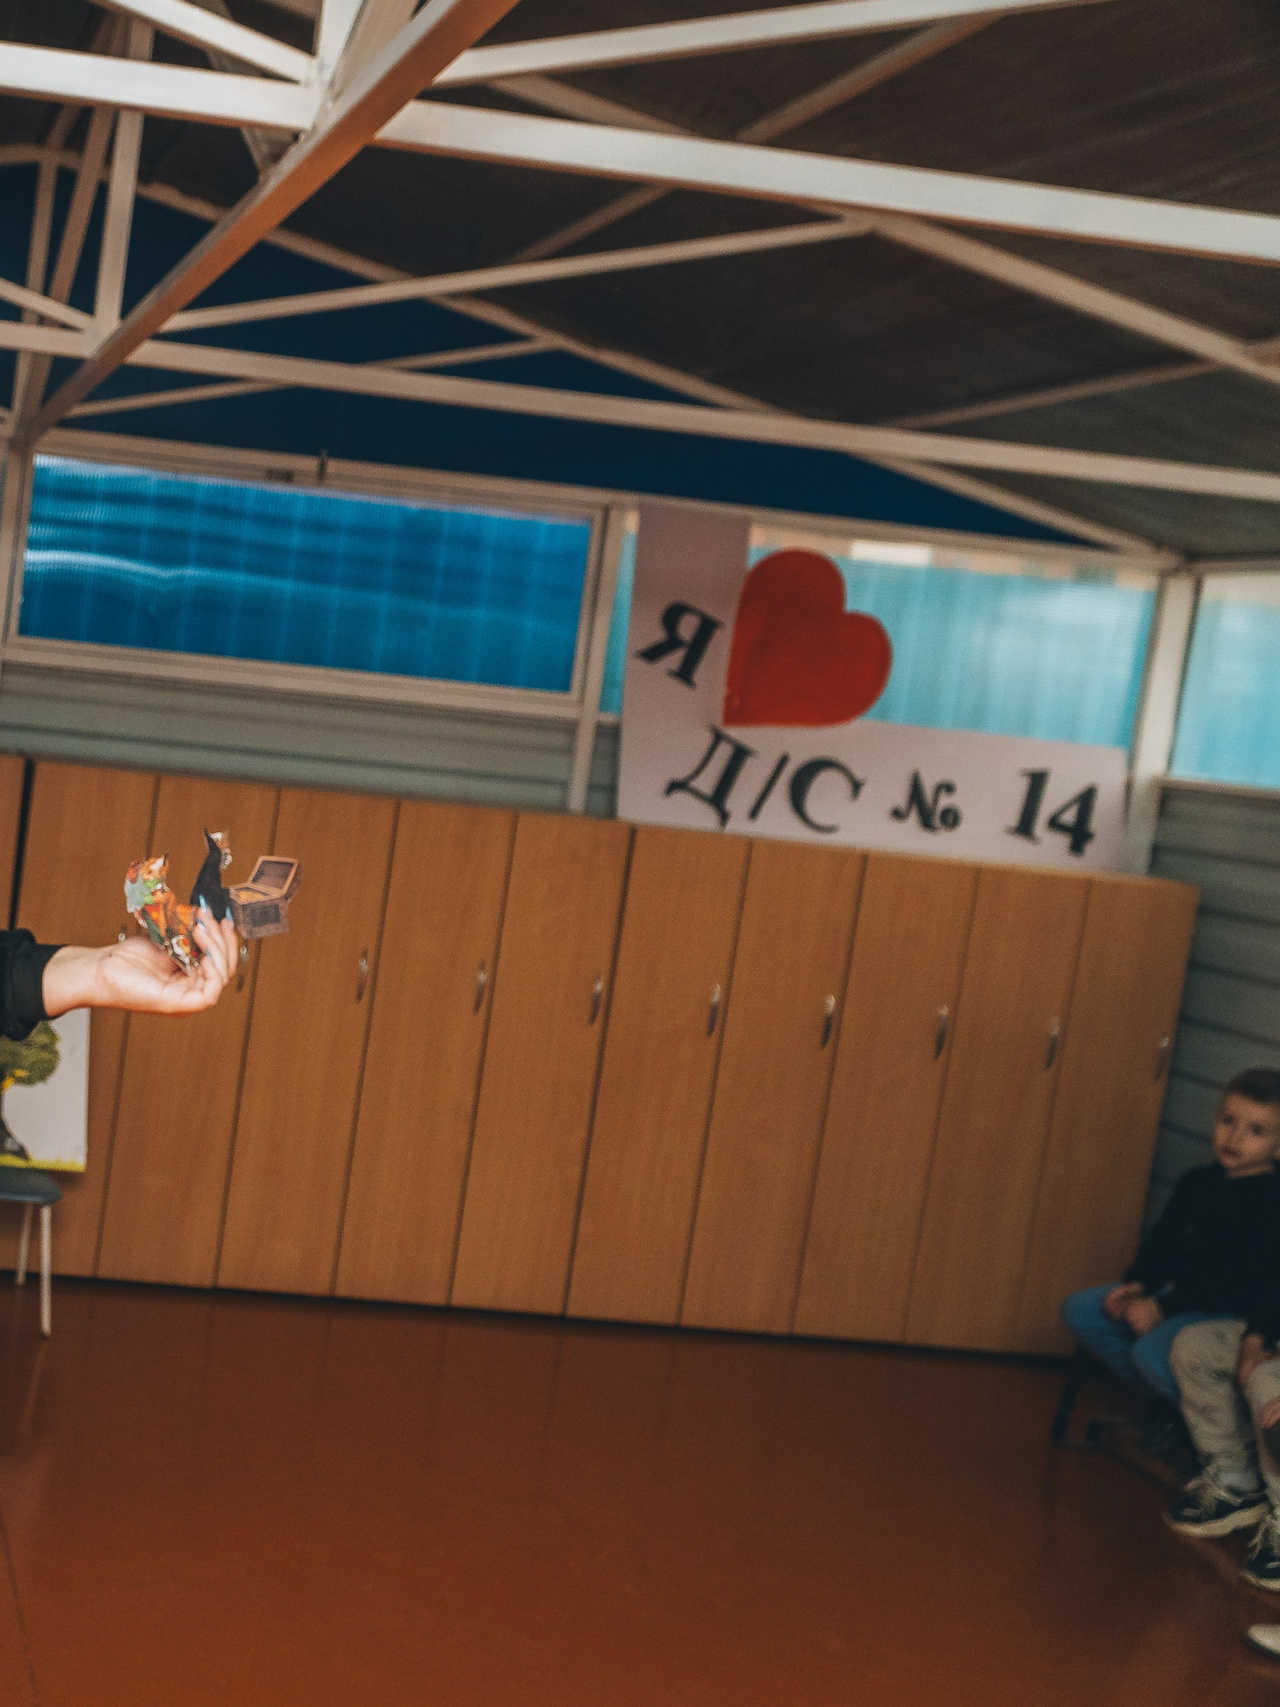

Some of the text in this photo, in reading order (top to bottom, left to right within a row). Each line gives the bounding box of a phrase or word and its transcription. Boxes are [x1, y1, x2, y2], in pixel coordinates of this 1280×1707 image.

[636, 601, 723, 688] Я
[665, 726, 1098, 857] Д/С № 14
